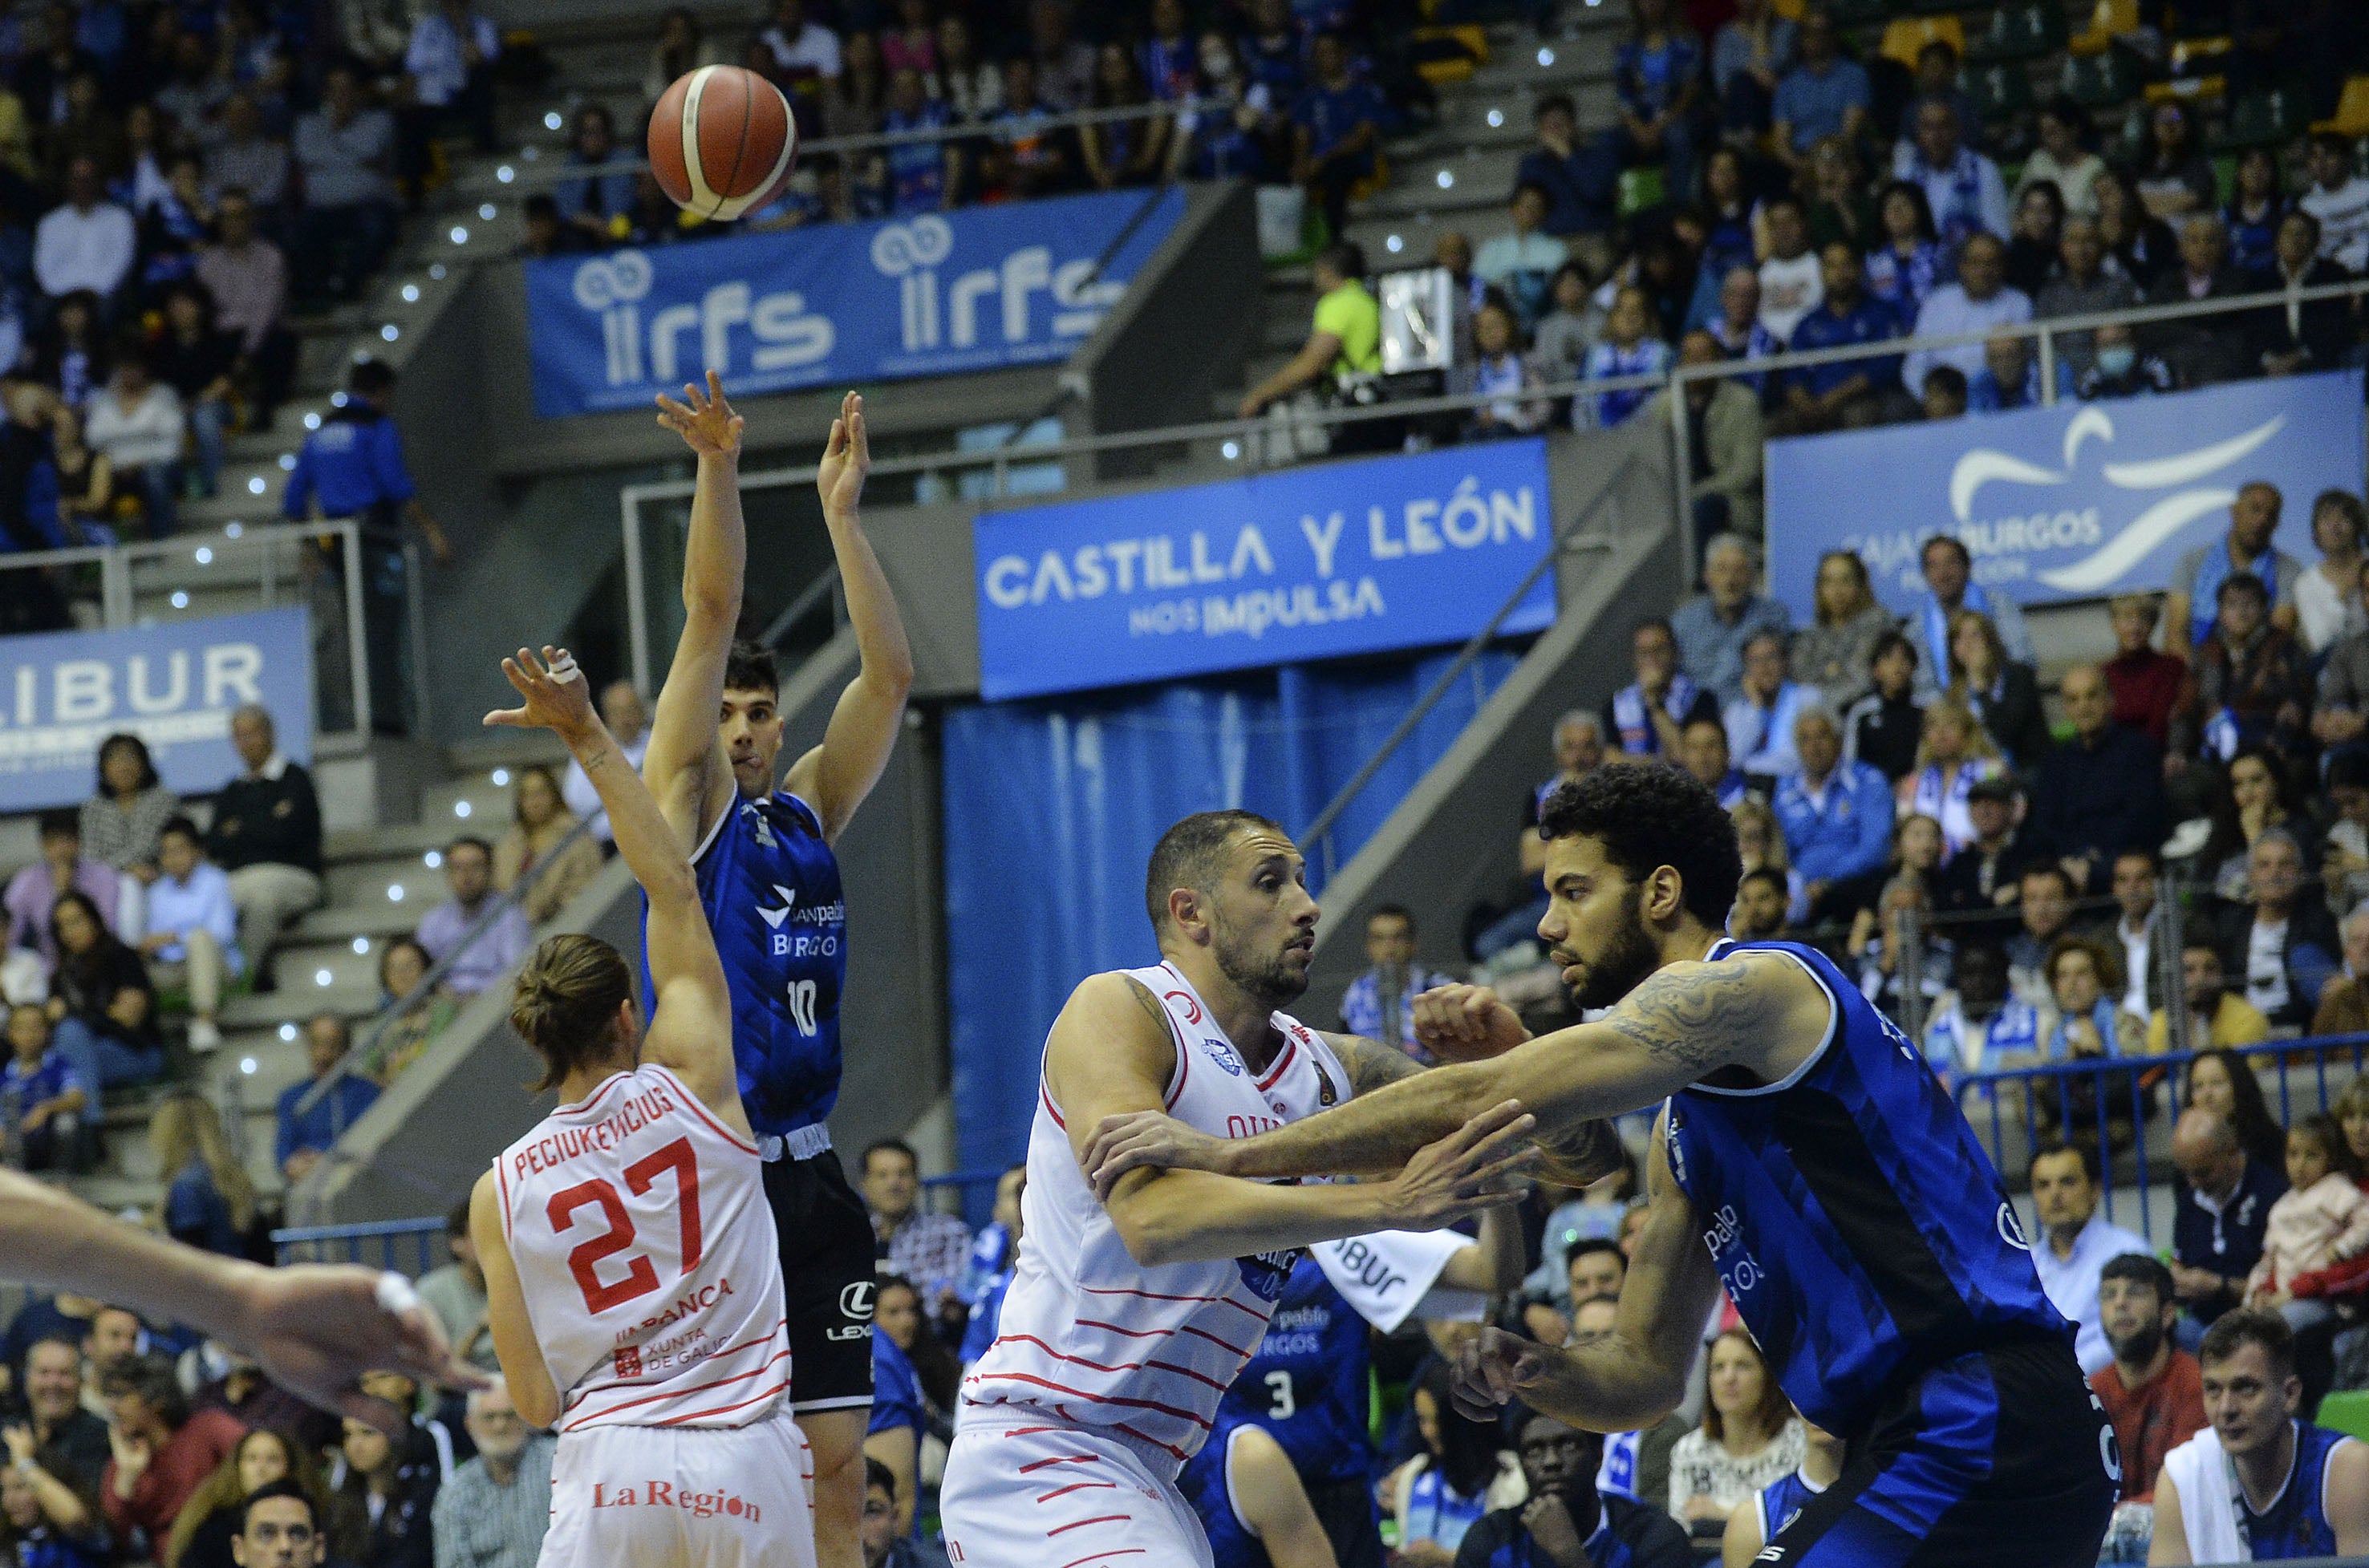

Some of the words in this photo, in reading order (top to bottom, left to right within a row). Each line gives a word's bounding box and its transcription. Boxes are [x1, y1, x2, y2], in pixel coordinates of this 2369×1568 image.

[984, 523, 1275, 609] CASTILLA
[1300, 511, 1345, 578] Y
[1366, 475, 1535, 560] LEÓN
[0, 642, 266, 725] IBUR
[787, 979, 817, 1037] 10
[546, 1136, 704, 1315] 27
[649, 1355, 673, 1371] DE
[1264, 1370, 1296, 1420] 3
[593, 1481, 636, 1509] La
